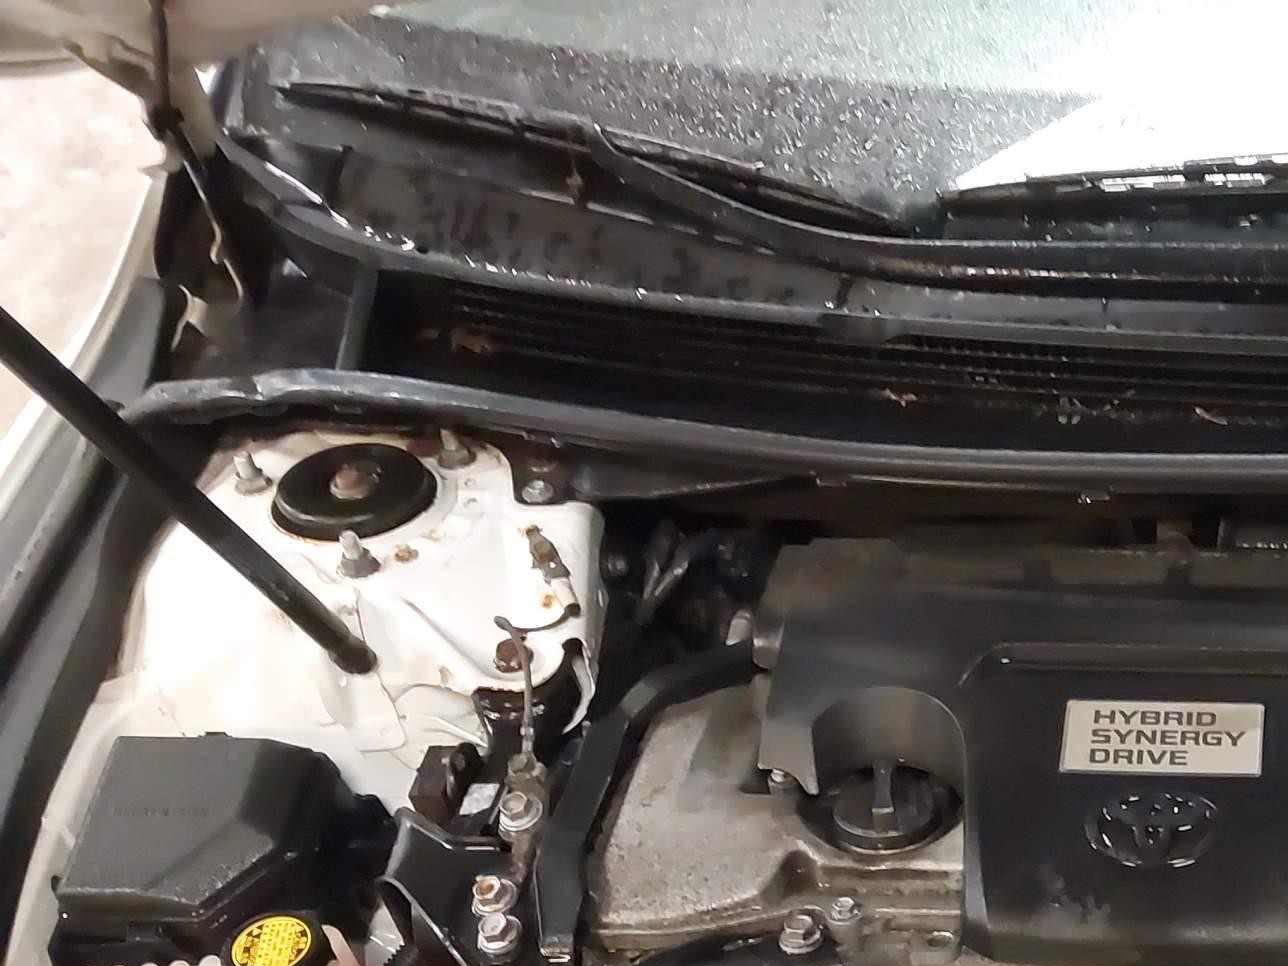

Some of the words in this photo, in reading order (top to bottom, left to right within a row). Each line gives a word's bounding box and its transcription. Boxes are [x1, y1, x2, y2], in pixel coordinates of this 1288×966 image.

[1093, 710, 1217, 726] HYBRID
[1090, 728, 1247, 747] SYNERGY
[1089, 748, 1189, 766] DRIVE
